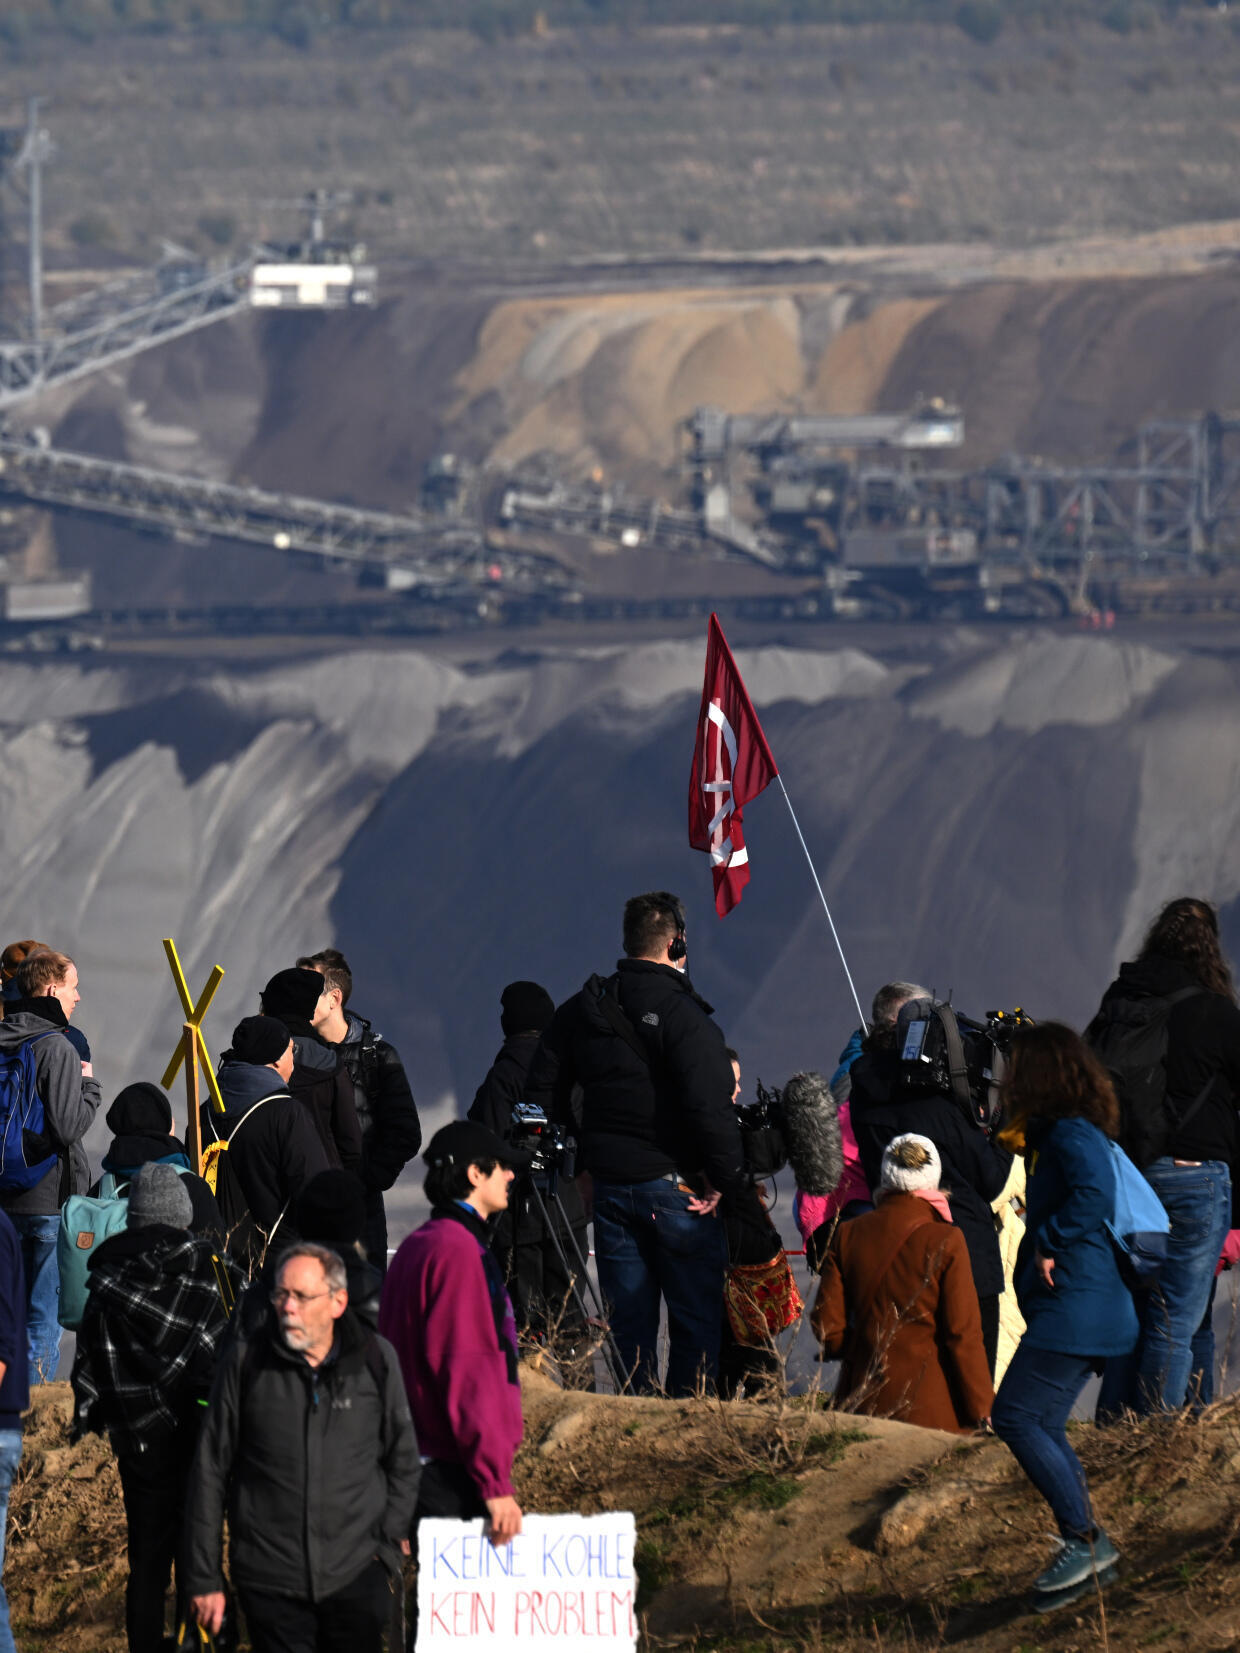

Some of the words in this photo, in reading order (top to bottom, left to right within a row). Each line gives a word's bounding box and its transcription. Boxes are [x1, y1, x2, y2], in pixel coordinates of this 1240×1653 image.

[432, 1533, 527, 1580] KEINE
[543, 1533, 633, 1579] KOHLE
[431, 1591, 496, 1637] KEIN
[514, 1589, 634, 1638] PROBLEM
